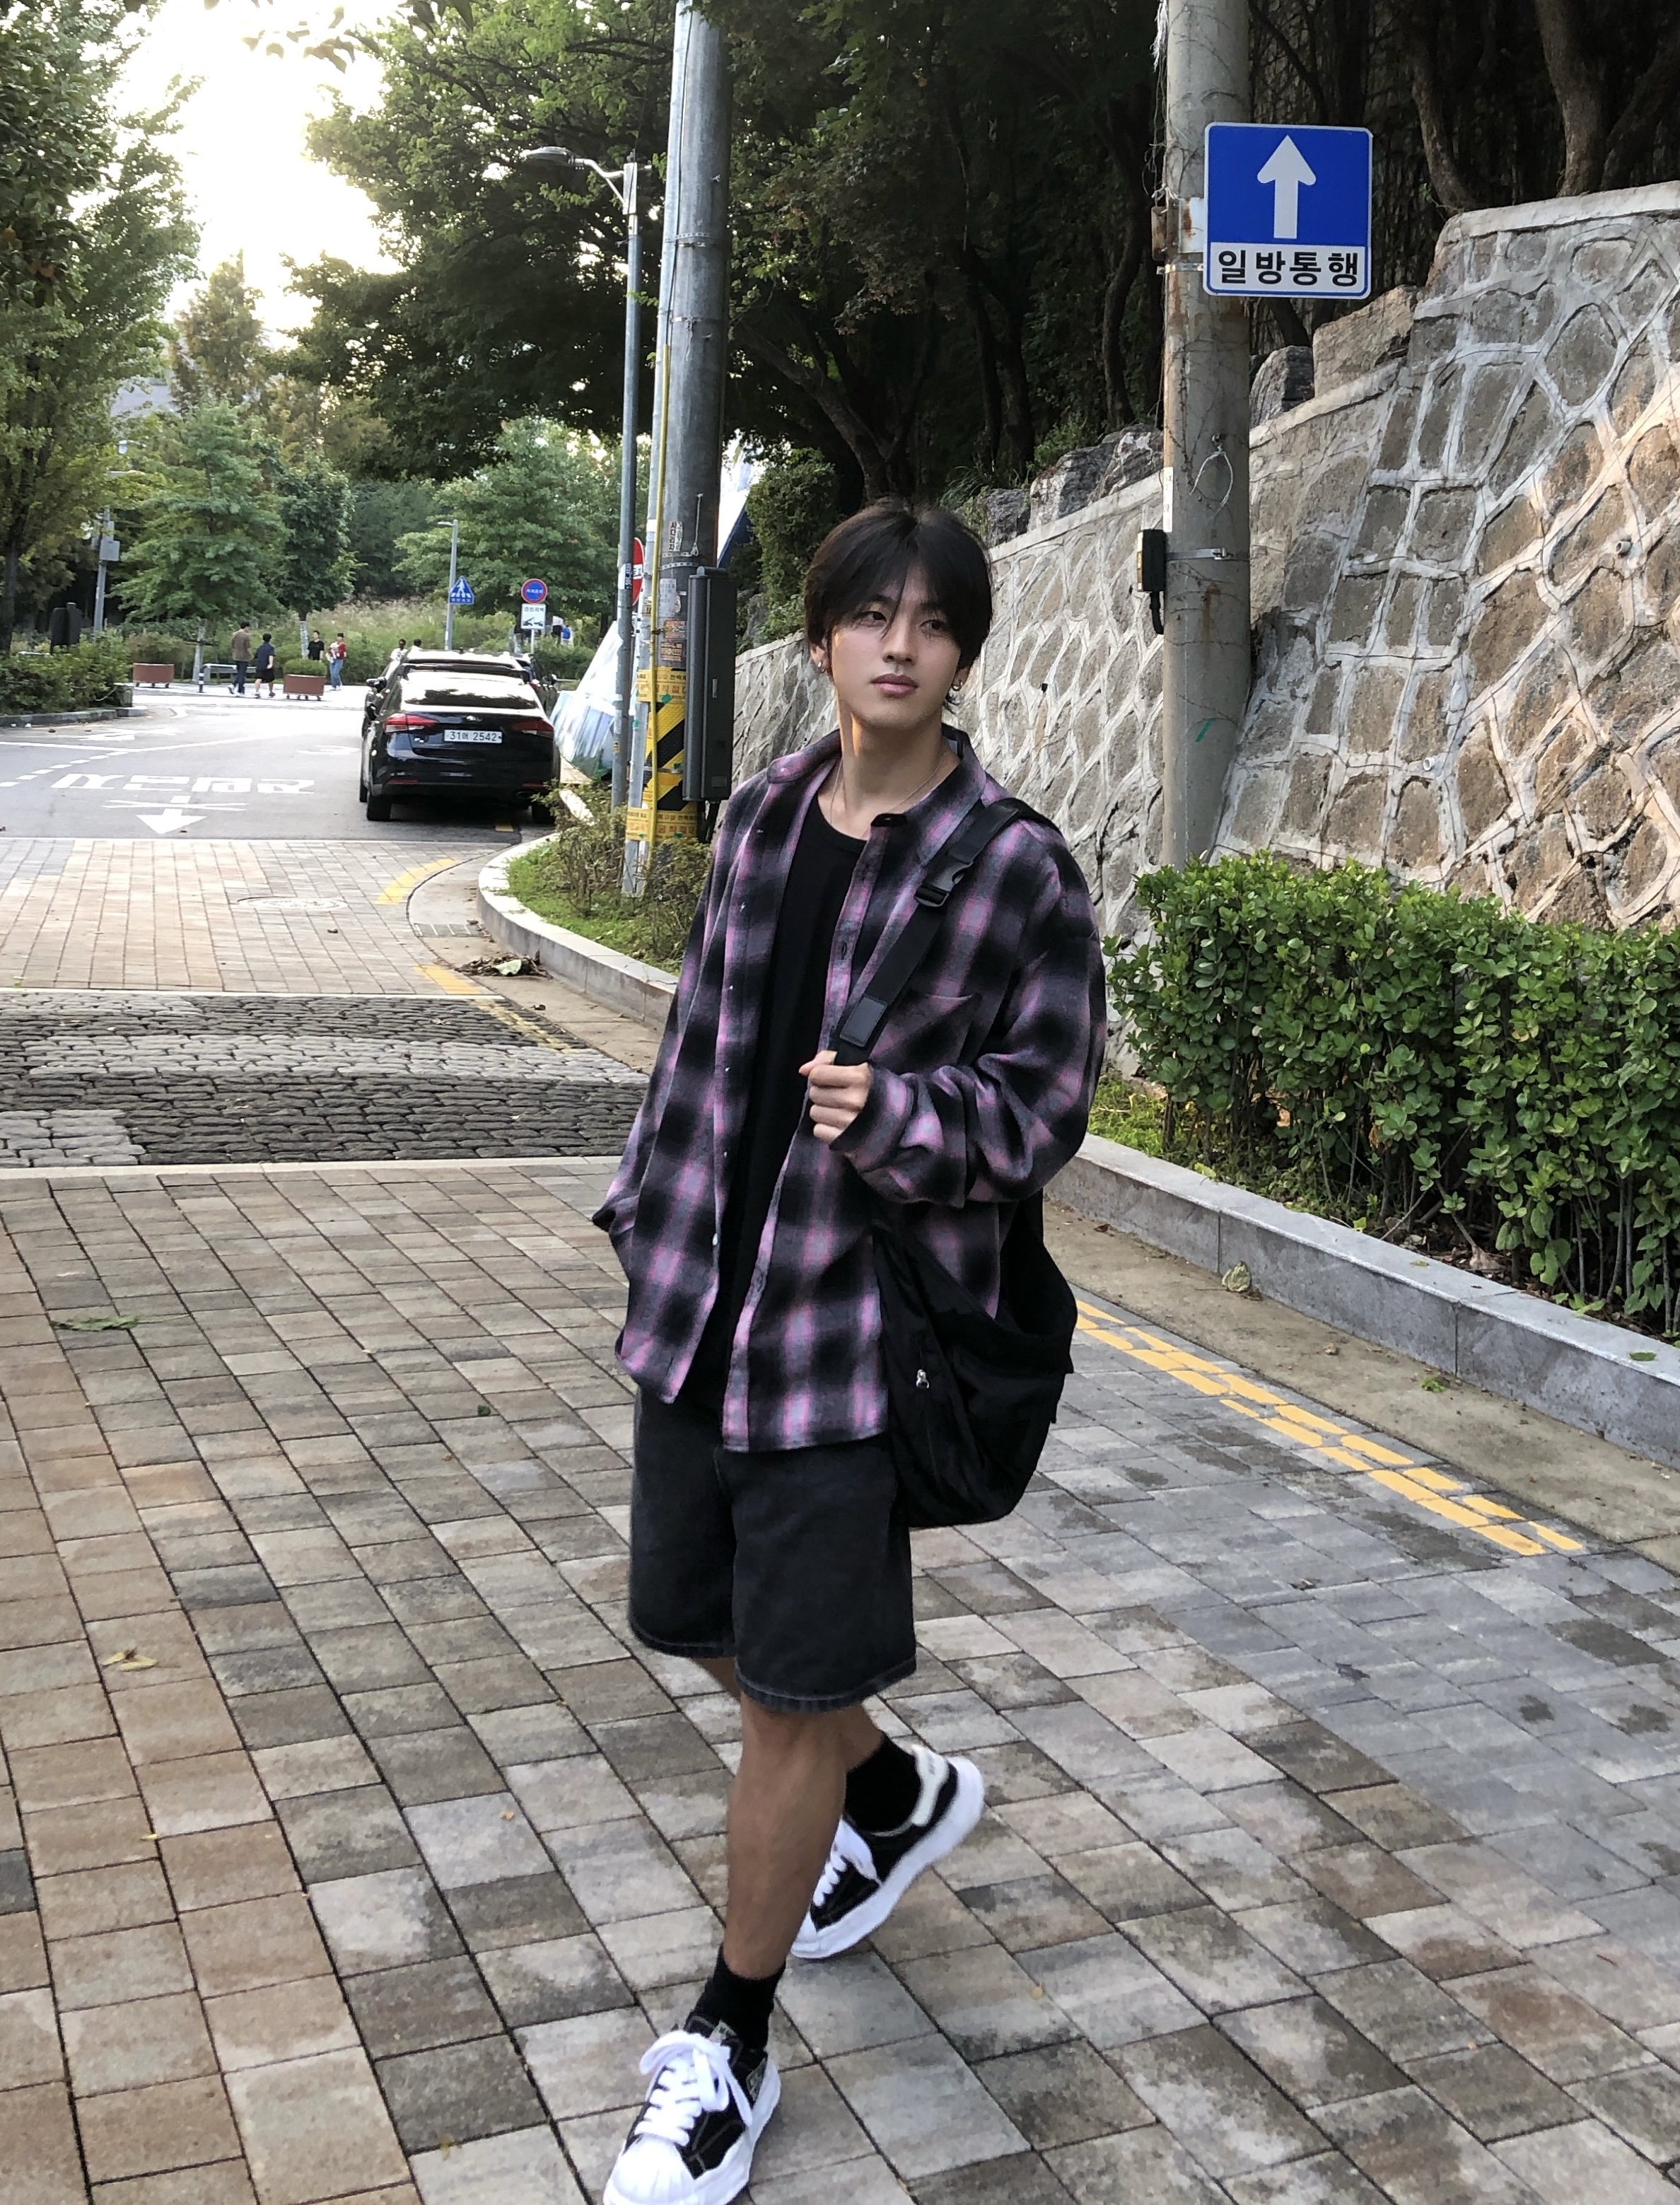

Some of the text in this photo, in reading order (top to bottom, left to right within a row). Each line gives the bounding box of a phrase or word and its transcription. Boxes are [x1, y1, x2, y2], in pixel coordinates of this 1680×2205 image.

[1218, 250, 1358, 286] 일방통행
[473, 732, 497, 741] 2542
[50, 773, 315, 794] 진입금지
